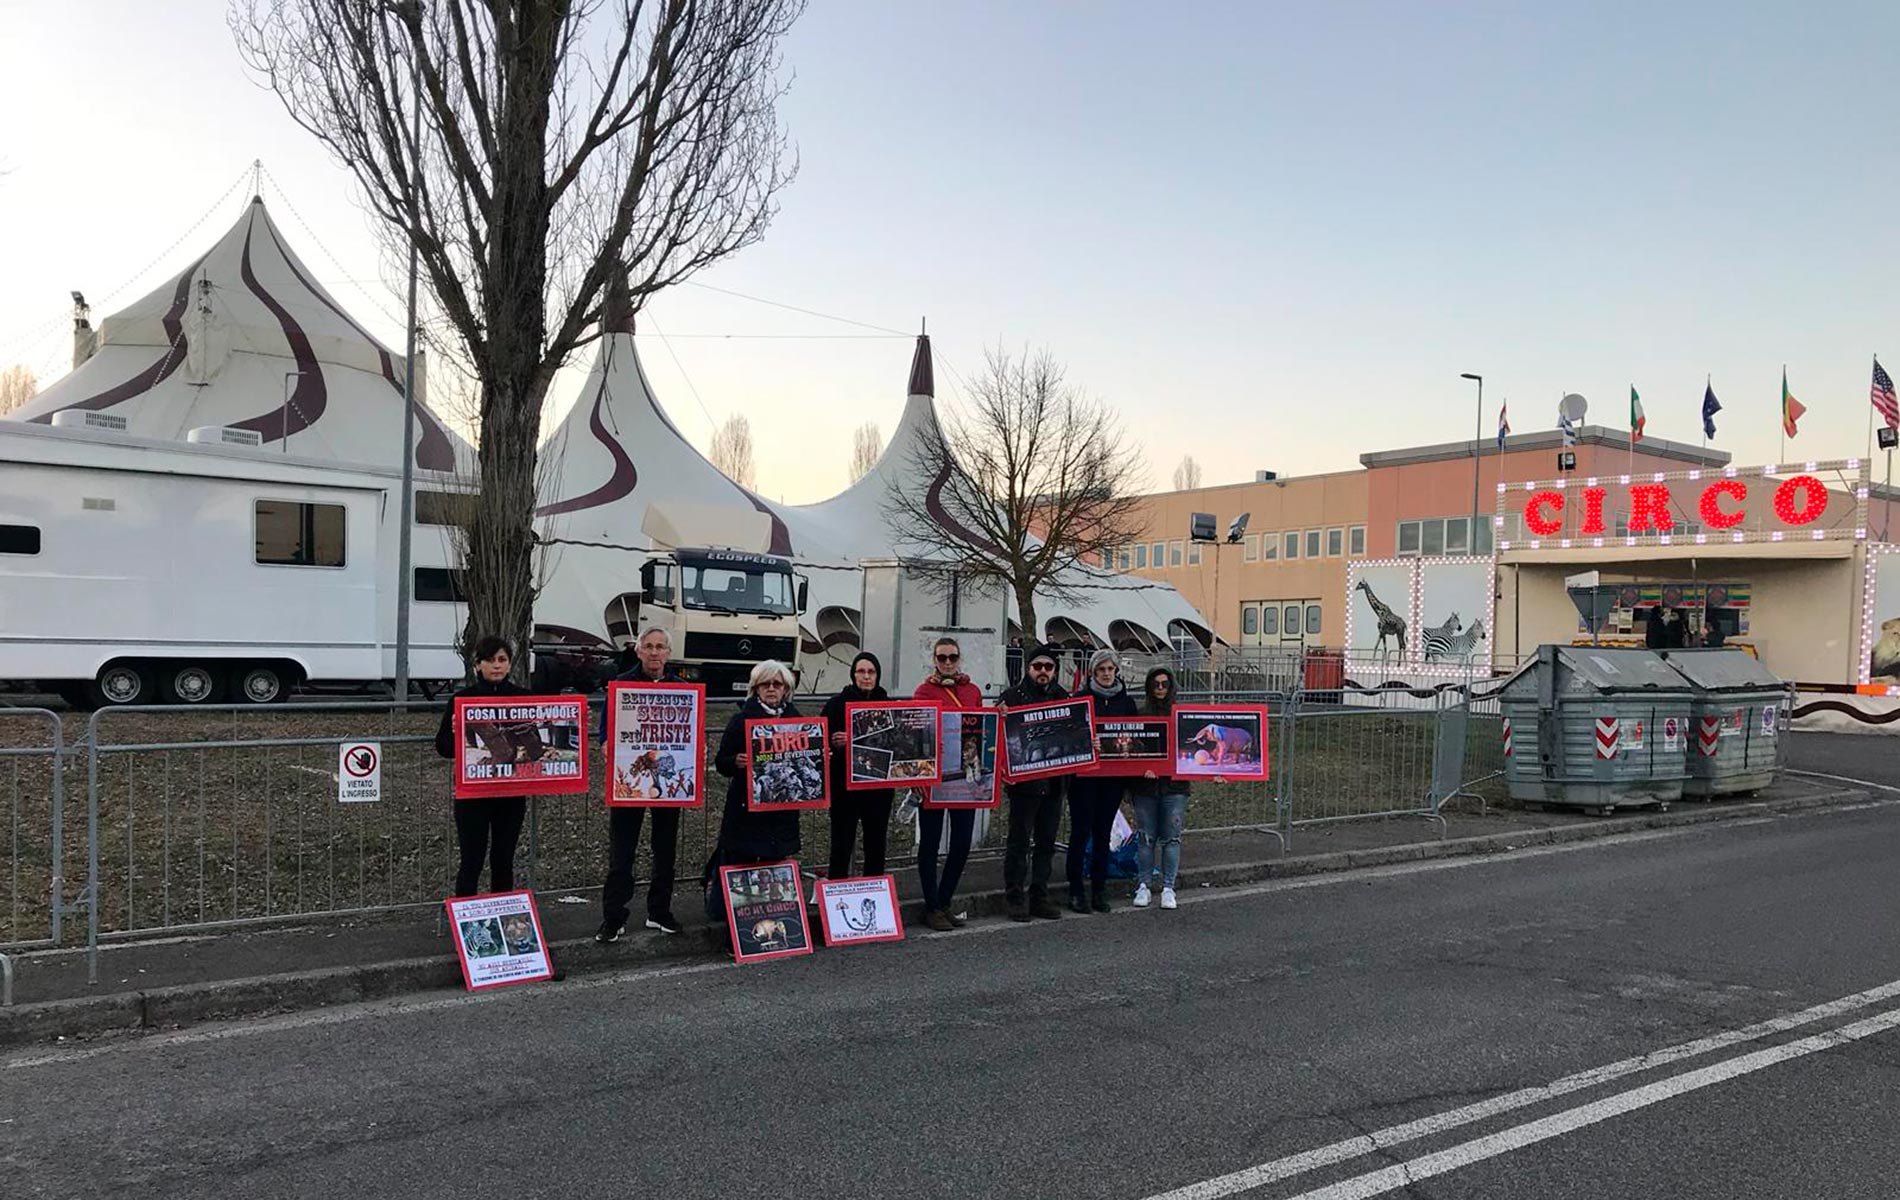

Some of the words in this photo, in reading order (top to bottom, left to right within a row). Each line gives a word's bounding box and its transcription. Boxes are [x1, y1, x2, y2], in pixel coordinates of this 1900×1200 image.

[1524, 475, 1828, 536] CIRCO
[707, 553, 777, 565] ECOSPEED
[622, 693, 693, 706] BENVENUTI
[467, 708, 496, 720] COSA
[498, 709, 508, 720] IL
[510, 707, 543, 720] CIRCO
[637, 705, 692, 723] SHOW
[962, 716, 977, 726] NO
[1023, 711, 1044, 722] NATO
[1044, 707, 1071, 720] LIBERO
[640, 724, 691, 743] TRISTE
[760, 732, 810, 753] LORO
[467, 764, 493, 778] CHE
[496, 764, 512, 777] TU
[545, 761, 577, 775] VEDA
[347, 780, 374, 788] VIETATO
